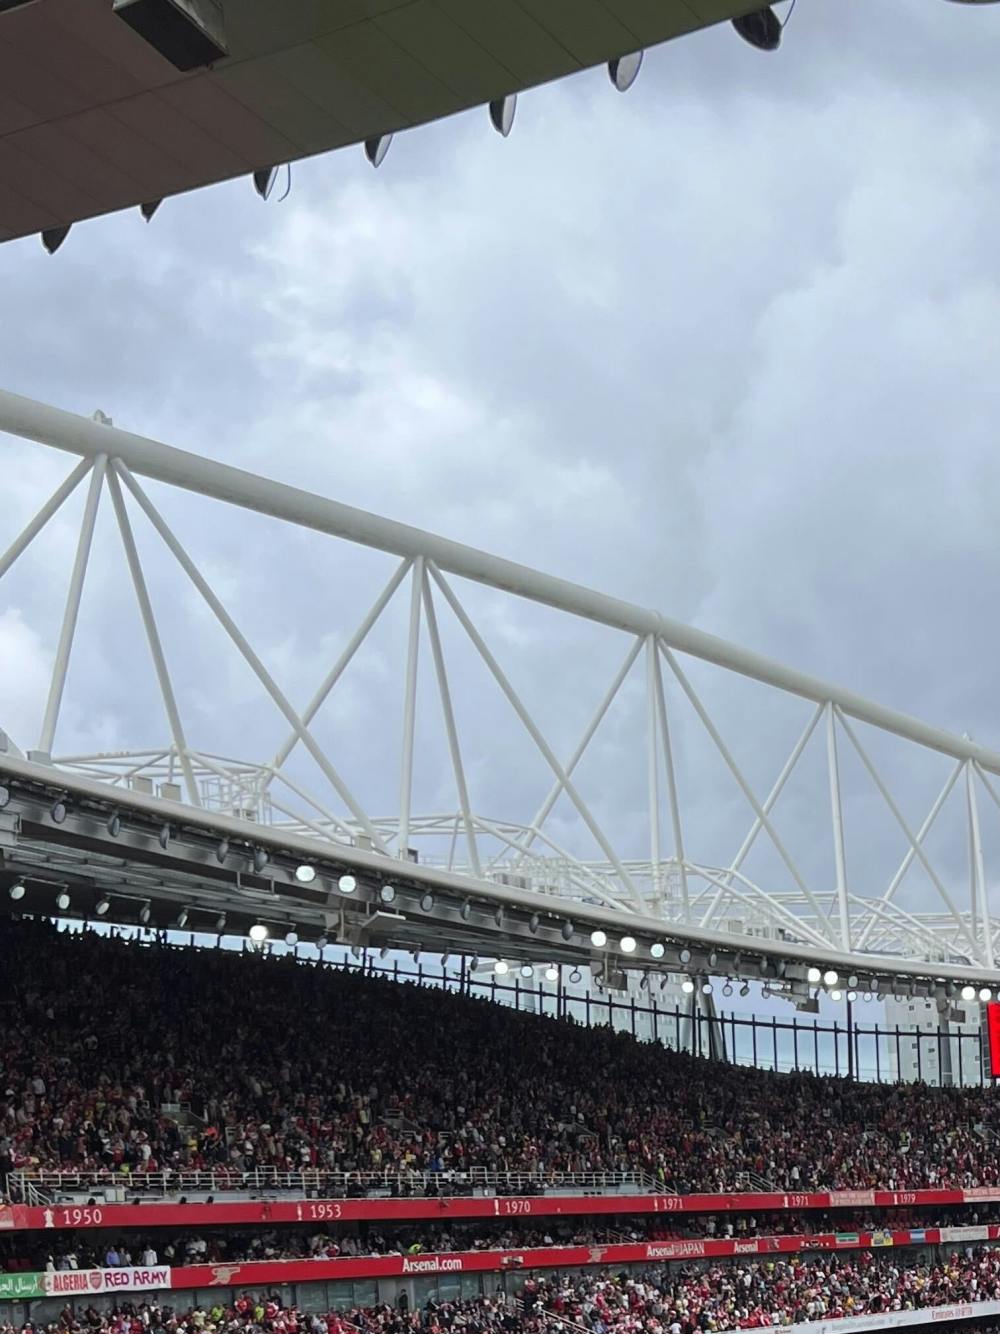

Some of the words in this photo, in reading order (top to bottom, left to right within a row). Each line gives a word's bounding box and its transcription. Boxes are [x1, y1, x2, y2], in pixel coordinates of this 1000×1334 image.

[505, 1200, 531, 1213] 1970
[663, 1198, 683, 1210] 1971
[791, 1196, 809, 1207] 1971
[63, 1209, 102, 1225] 1950
[310, 1204, 342, 1219] 1953
[646, 1244, 675, 1257] Arsenal
[680, 1242, 705, 1255] JAPAN
[734, 1241, 758, 1254] Arsenal
[402, 1256, 462, 1273] Arsenal.com
[53, 1273, 89, 1292] ALGERIA
[105, 1272, 130, 1288] RED
[133, 1270, 168, 1287] ARMY
